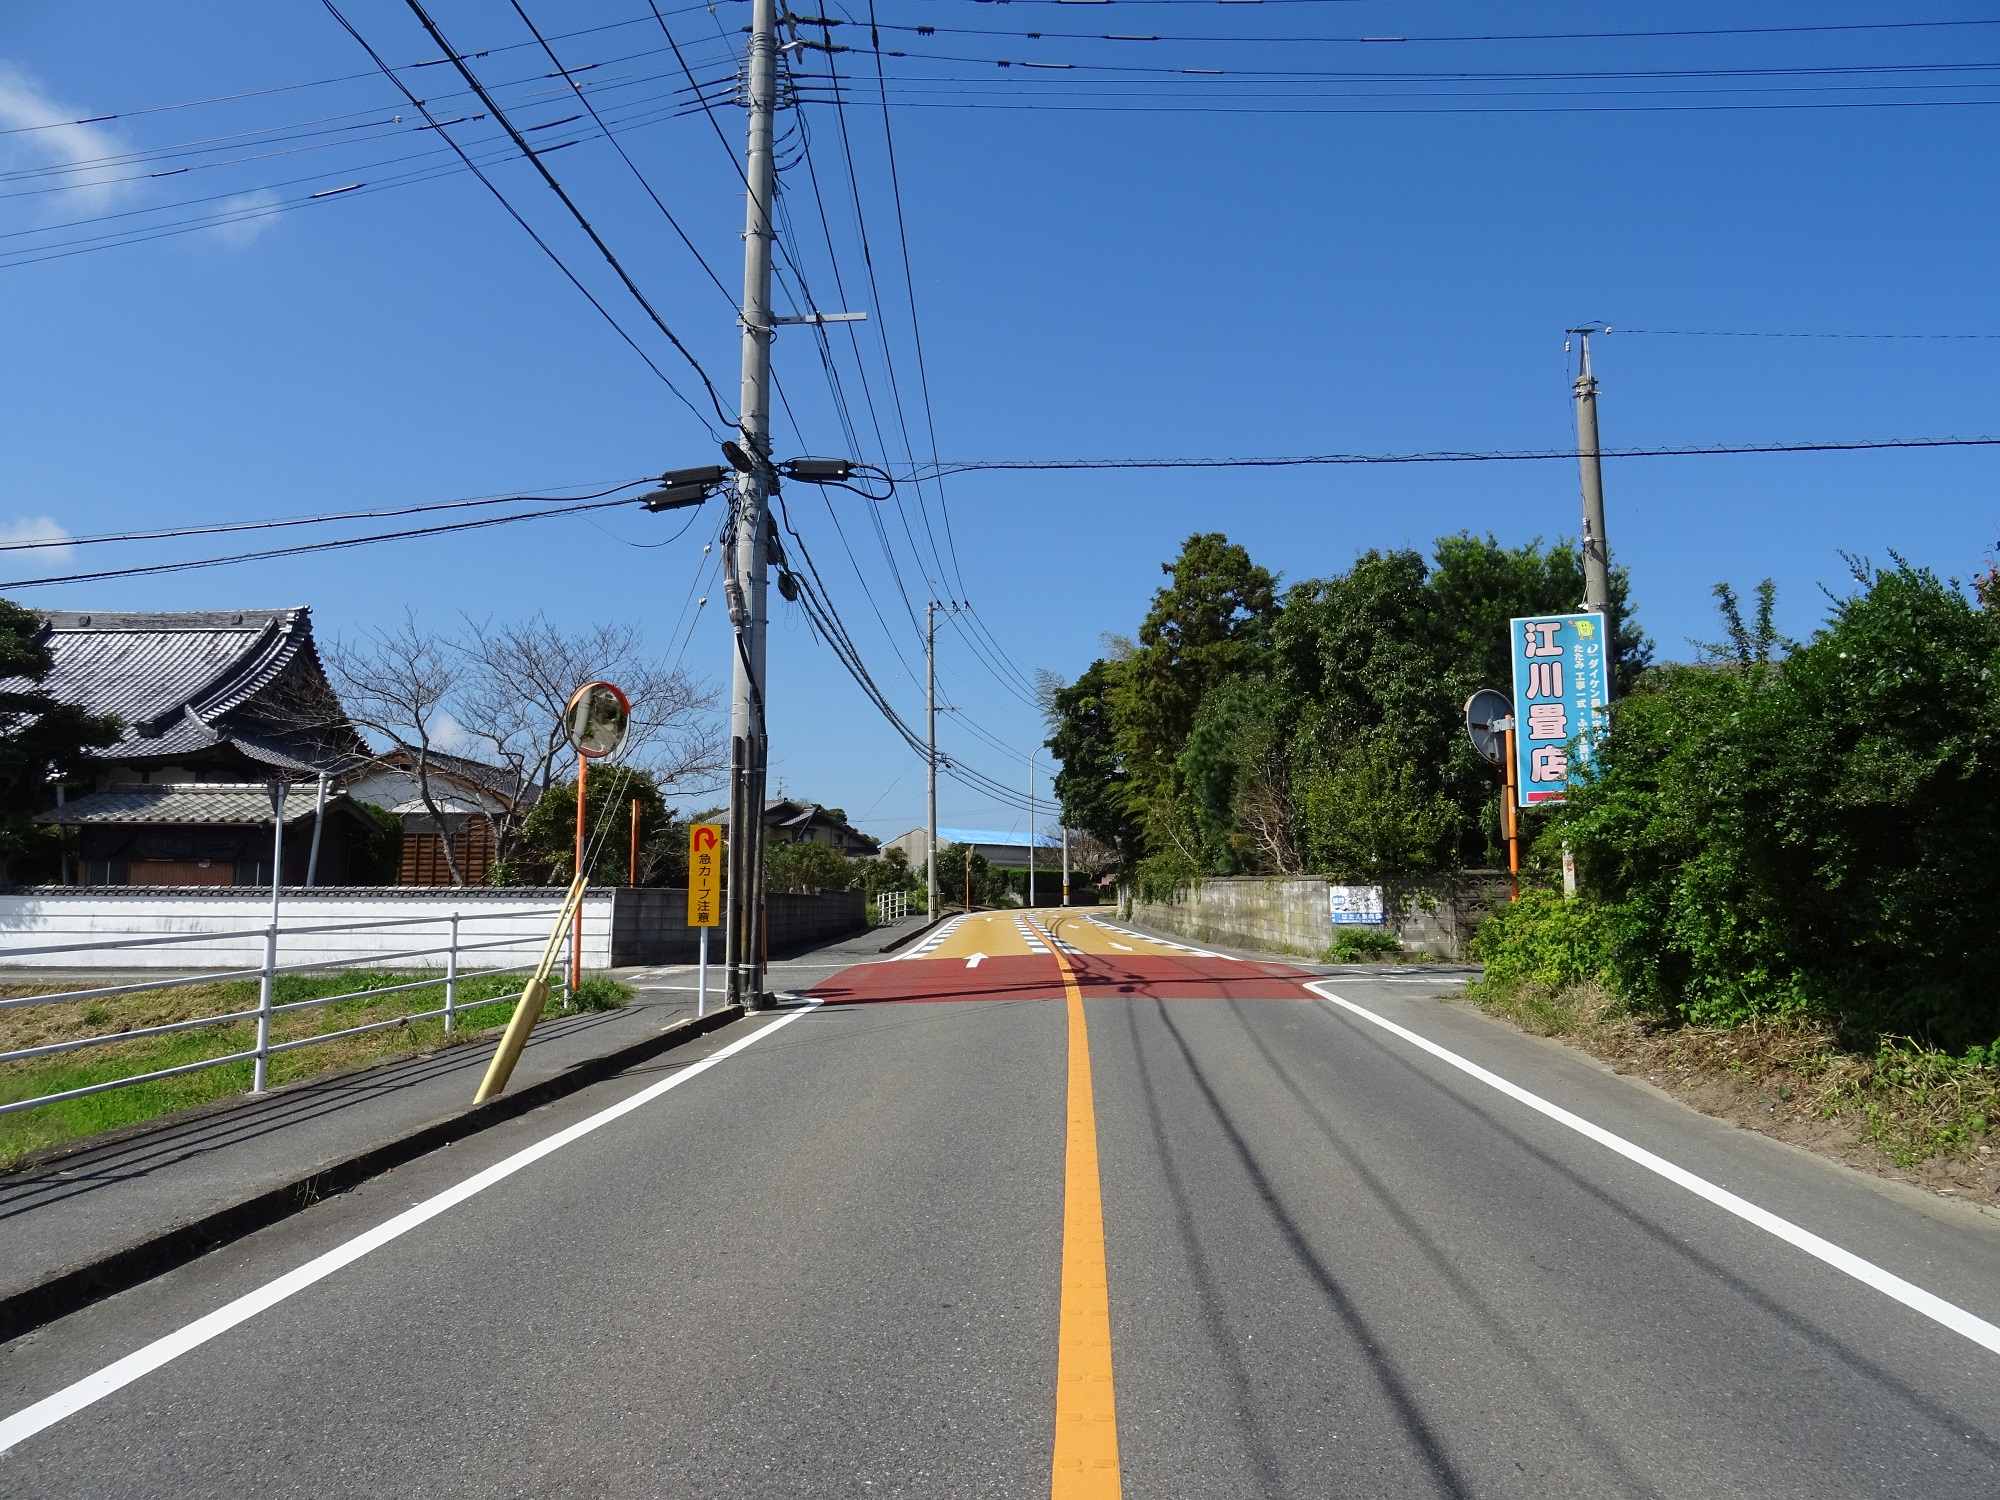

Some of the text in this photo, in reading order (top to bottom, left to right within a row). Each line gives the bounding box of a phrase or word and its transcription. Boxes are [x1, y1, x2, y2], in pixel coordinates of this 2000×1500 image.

[1523, 621, 1568, 783] 江川畳店
[697, 854, 712, 923] 急カーブ注意
